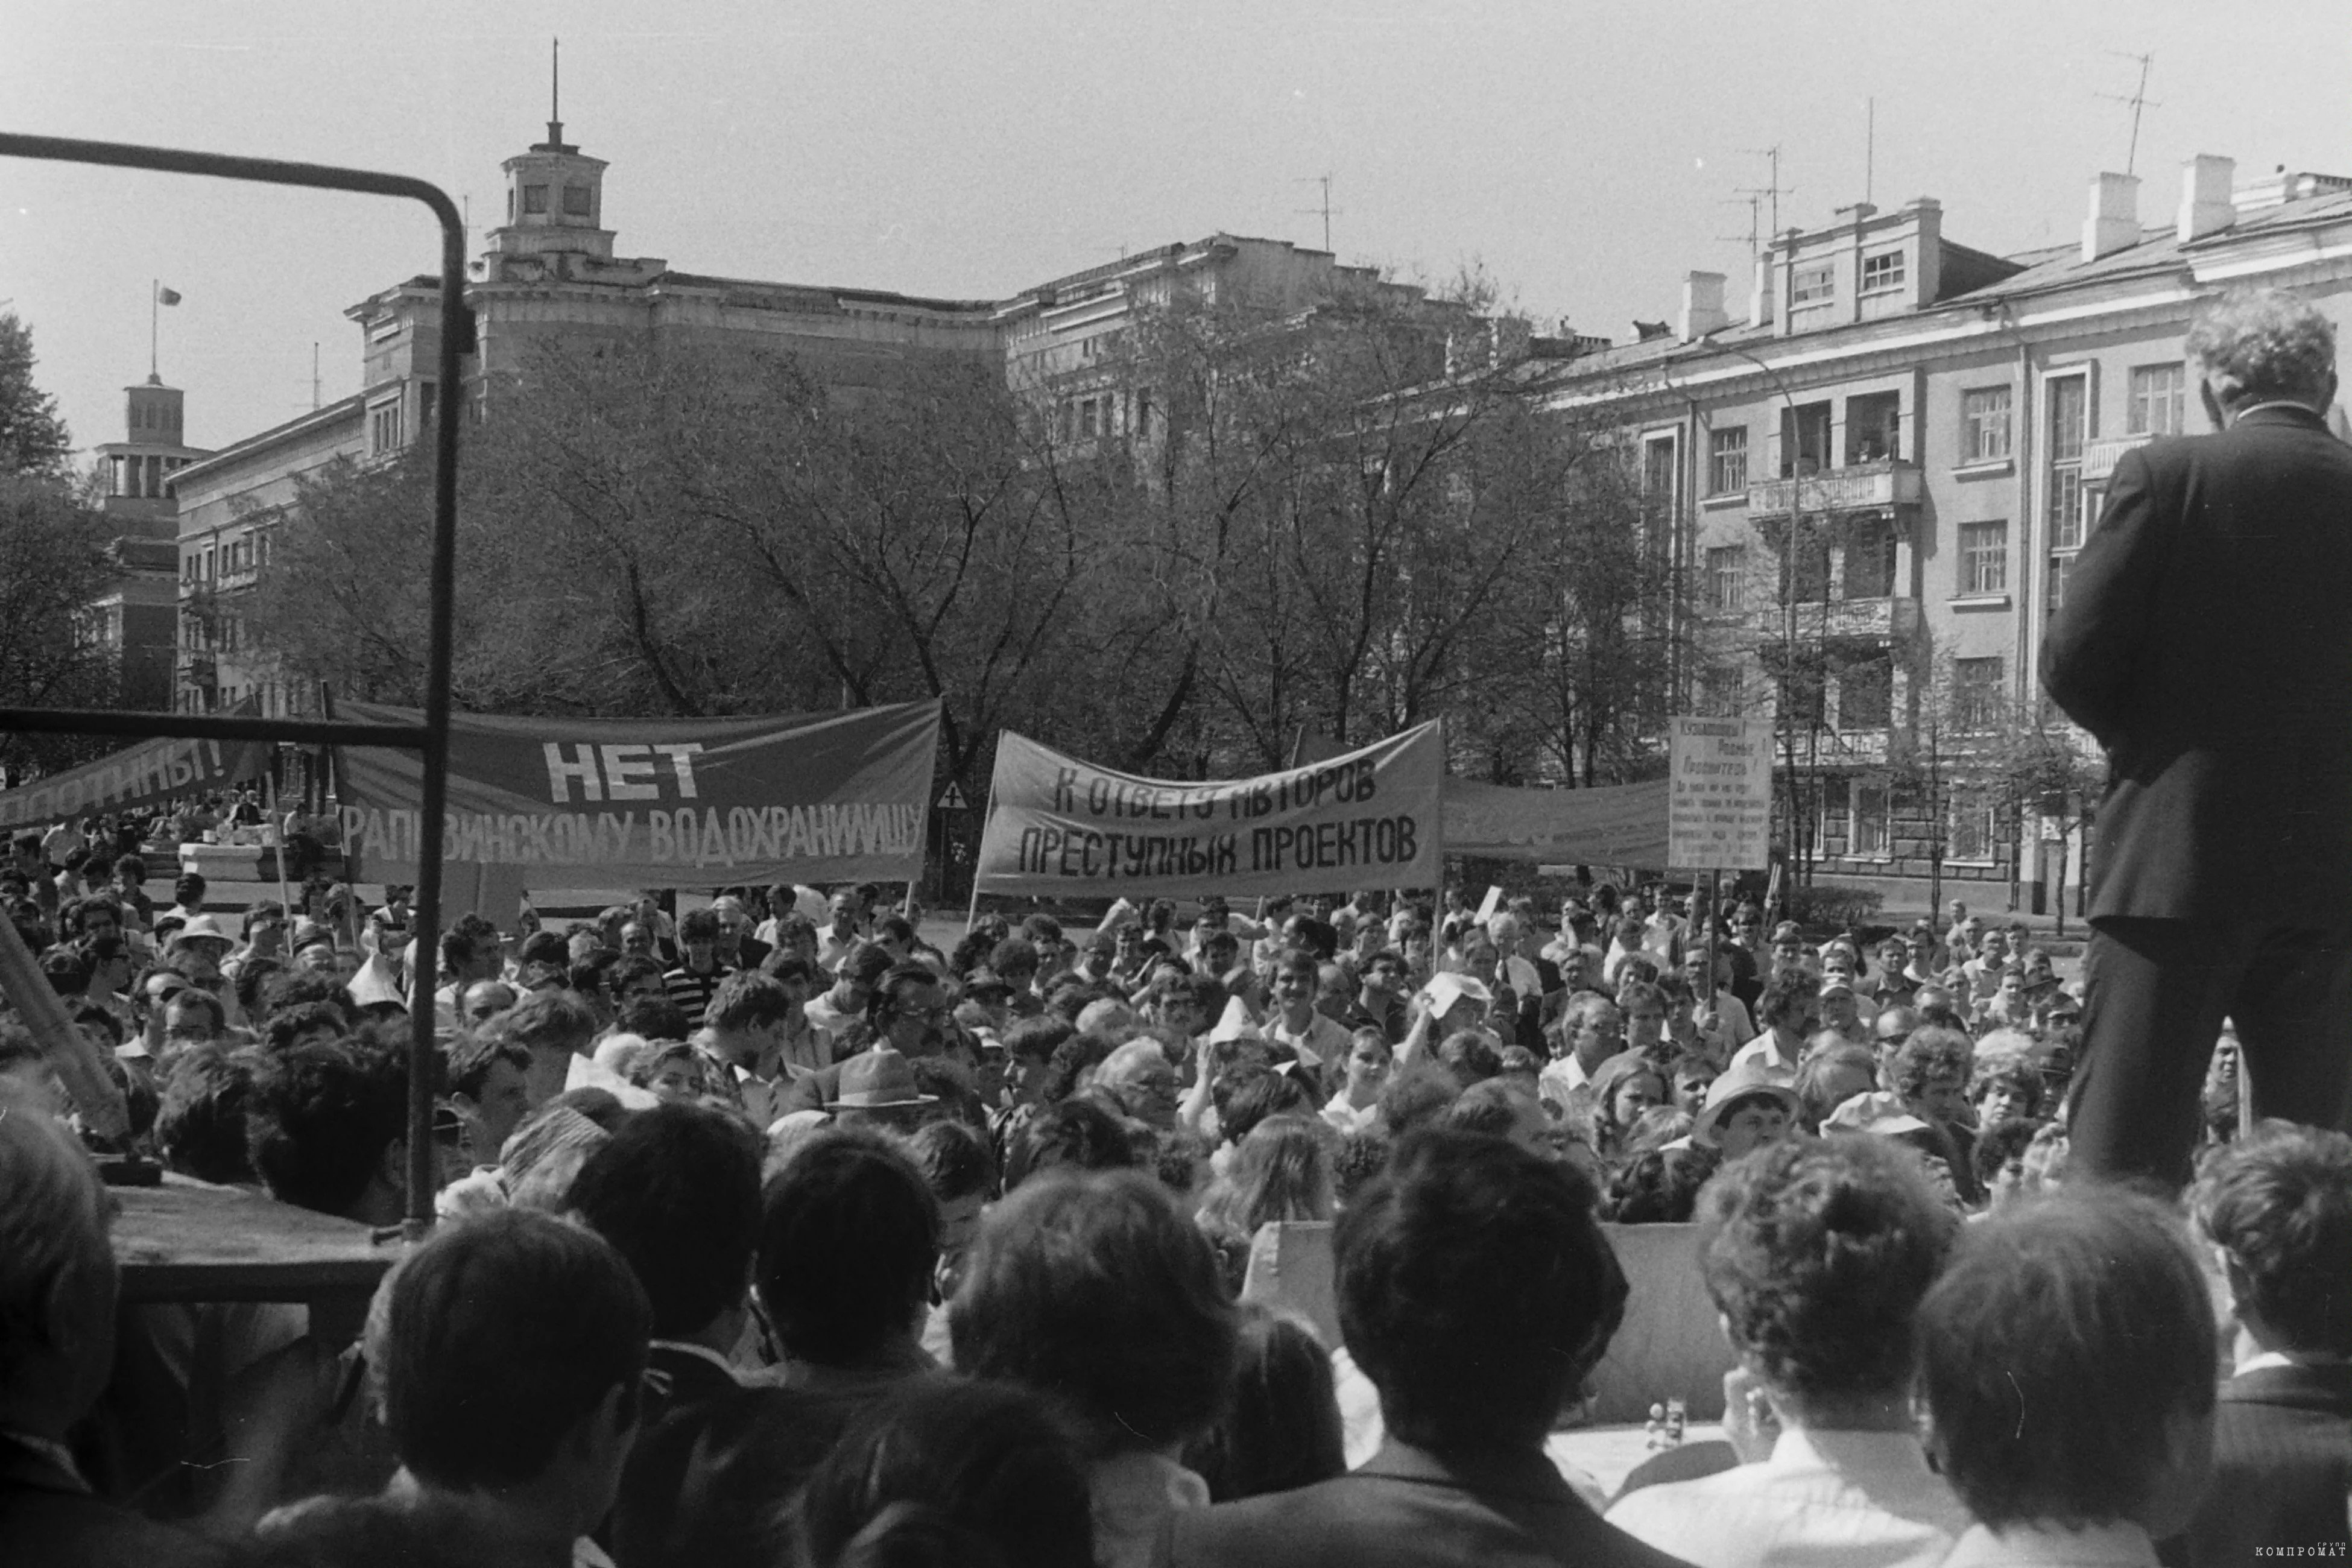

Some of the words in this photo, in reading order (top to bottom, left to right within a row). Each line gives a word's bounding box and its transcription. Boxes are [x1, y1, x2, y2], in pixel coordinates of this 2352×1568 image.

[543, 742, 703, 803] НЕТ
[1055, 767, 1078, 813] К
[650, 803, 924, 868] ВОДОХРАНИЛИЩУ
[1019, 826, 1236, 878] ПРЕСТУПНЫХ
[1252, 815, 1417, 871] ПРОЕКТОВ
